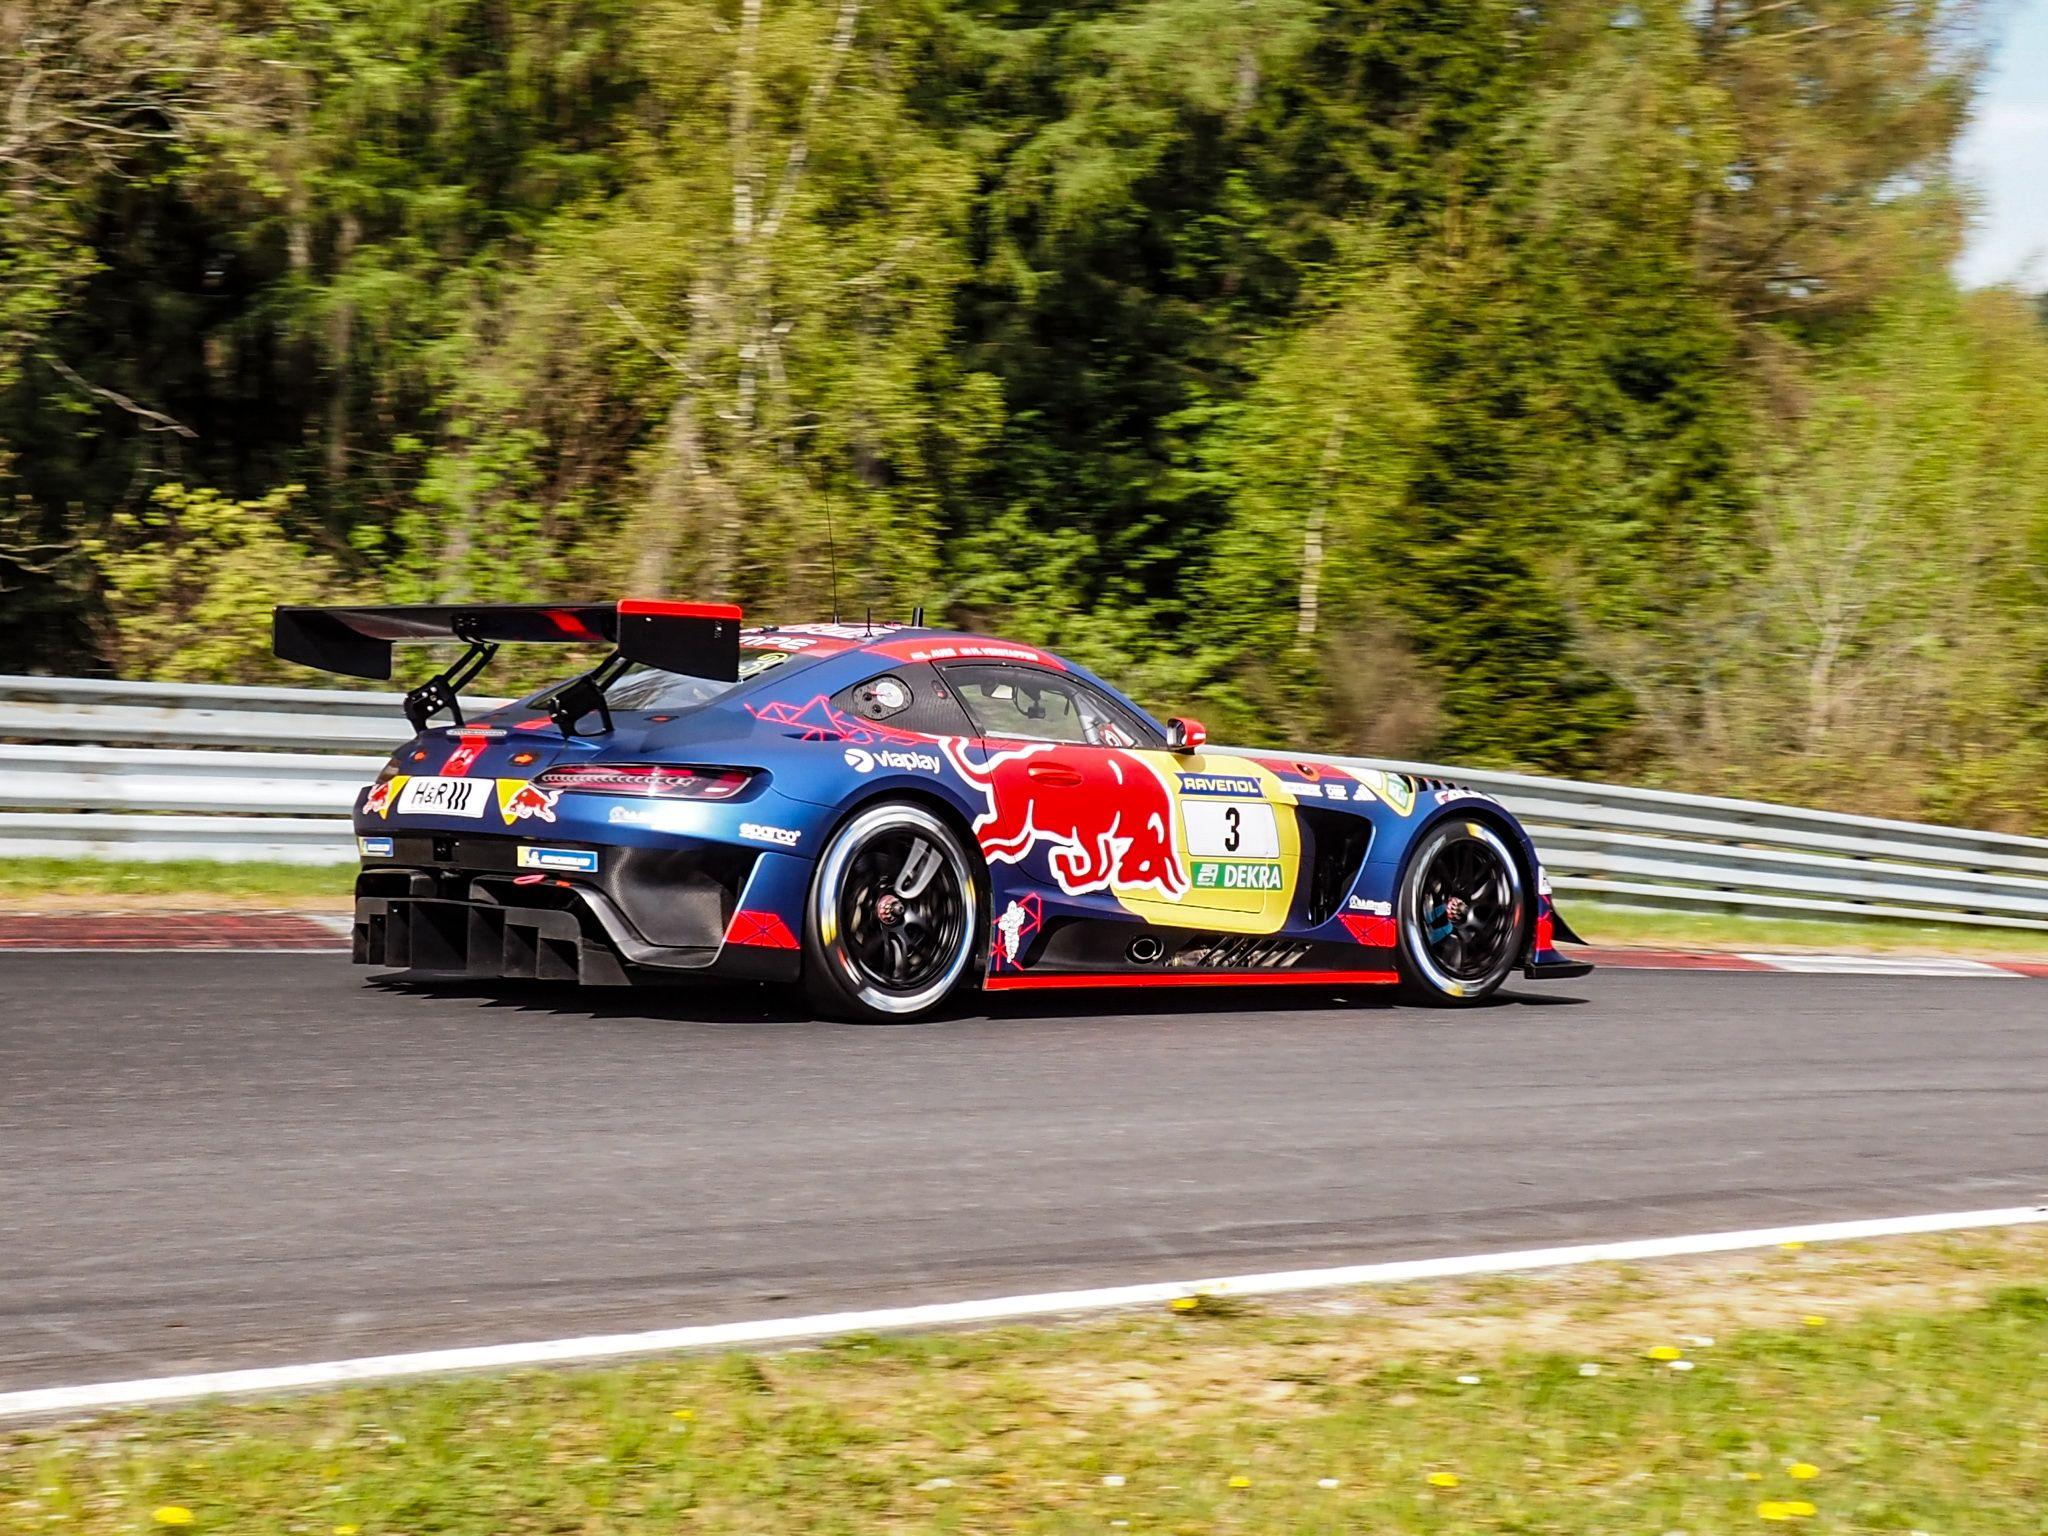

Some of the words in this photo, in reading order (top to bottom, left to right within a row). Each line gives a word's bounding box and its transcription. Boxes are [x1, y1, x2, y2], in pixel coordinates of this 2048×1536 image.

[873, 750, 941, 774] viaplay
[1183, 778, 1259, 793] RAVENOL
[1225, 807, 1240, 852] 3
[1223, 864, 1281, 889] DEKRA
